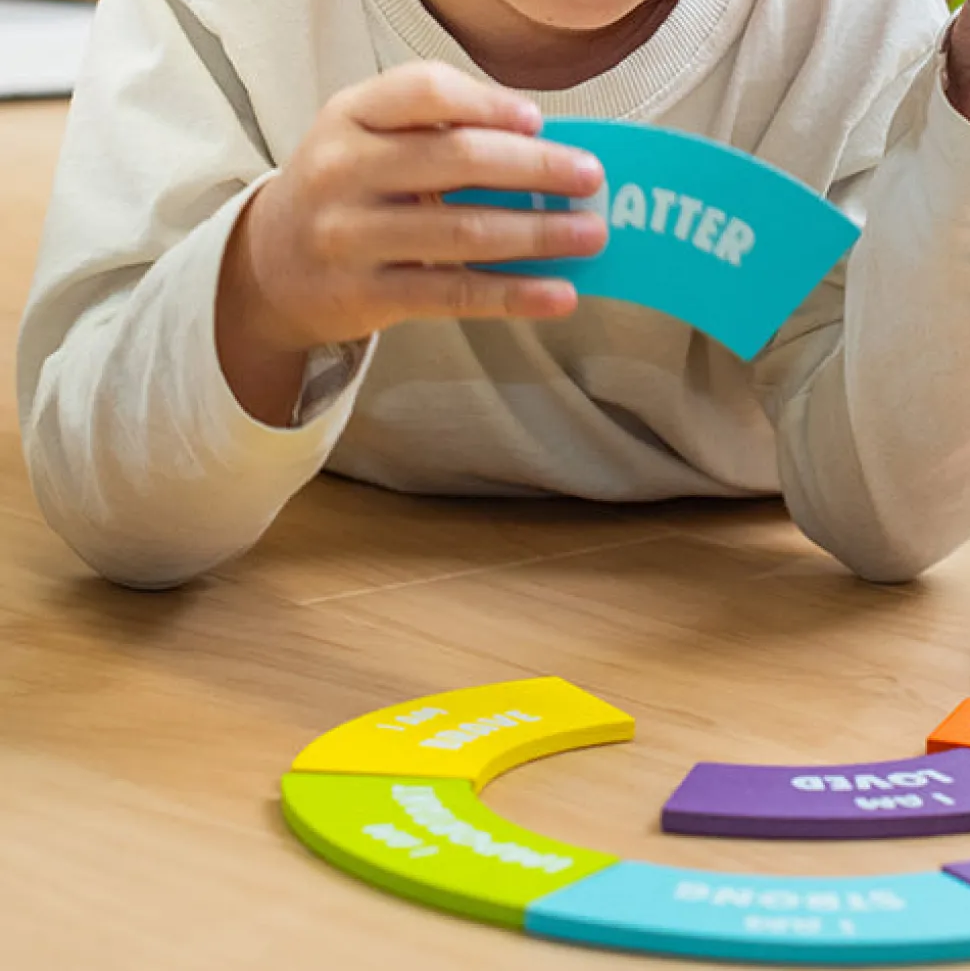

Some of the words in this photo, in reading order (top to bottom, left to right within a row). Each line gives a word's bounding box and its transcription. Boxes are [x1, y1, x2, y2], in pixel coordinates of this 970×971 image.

[791, 768, 954, 791] LOVED
[854, 794, 924, 811] AM
[932, 792, 955, 806] I
[675, 882, 905, 911] STRONG
